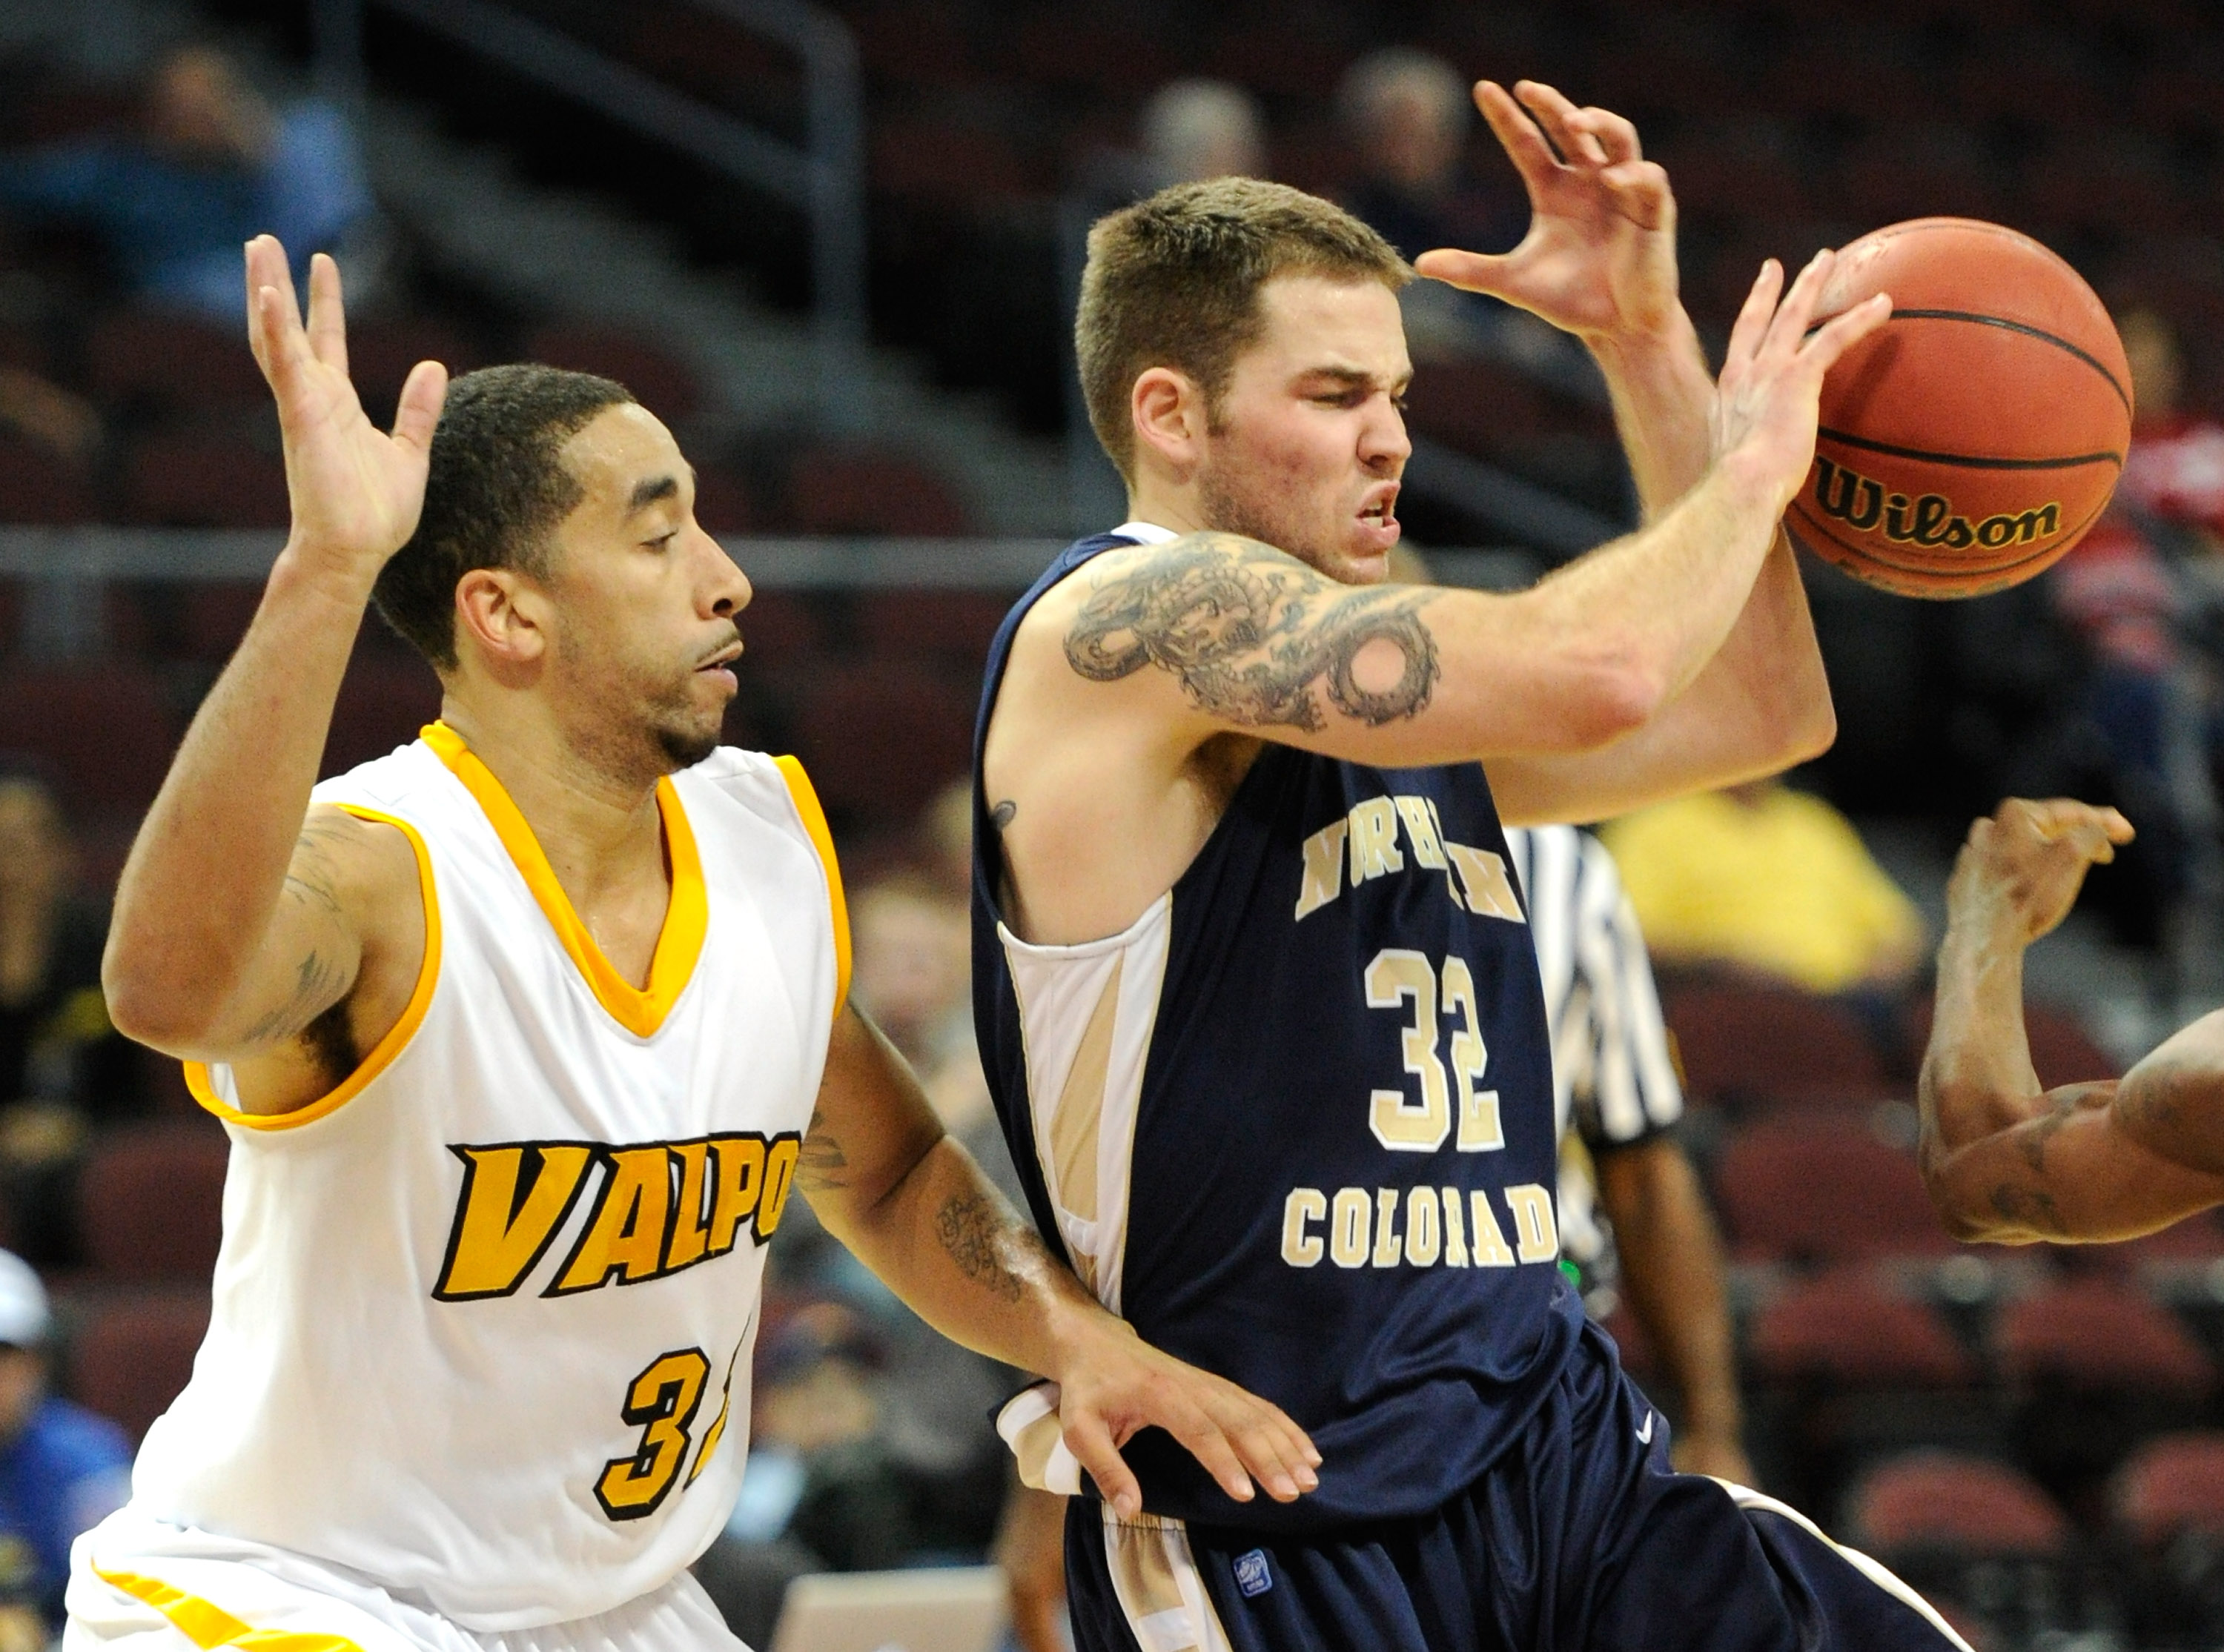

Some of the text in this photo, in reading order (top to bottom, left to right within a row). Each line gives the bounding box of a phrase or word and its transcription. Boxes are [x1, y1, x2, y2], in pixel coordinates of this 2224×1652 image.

[1814, 455, 2061, 551] Wilson
[1364, 949, 1505, 1152] 32
[431, 1130, 801, 1303] VALPO
[593, 1313, 752, 1522] 3
